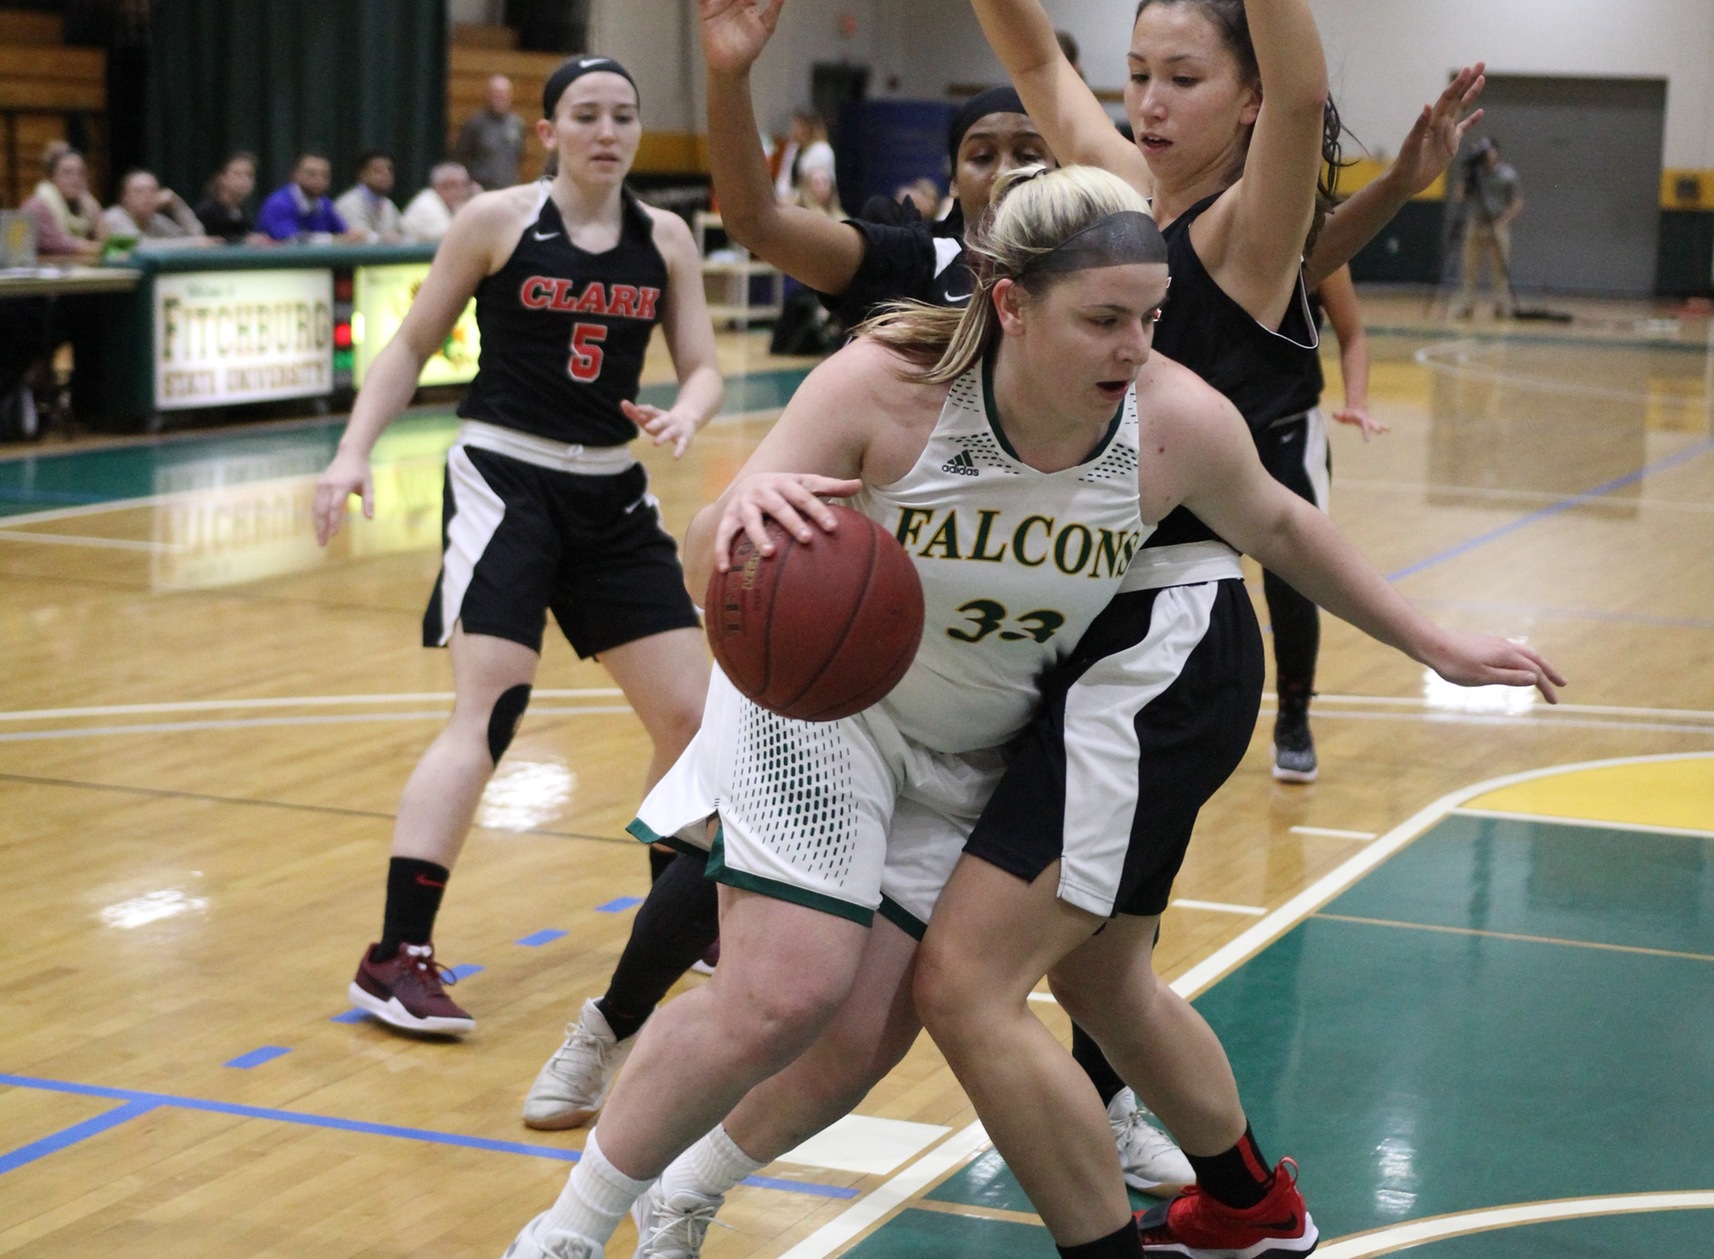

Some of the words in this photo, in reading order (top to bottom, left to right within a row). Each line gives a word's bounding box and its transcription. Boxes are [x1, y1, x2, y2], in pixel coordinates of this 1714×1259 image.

[520, 275, 660, 320] CLARK
[567, 322, 608, 383] 5
[941, 463, 980, 477] adidas
[896, 505, 1140, 579] FALCONS
[945, 597, 1066, 644] 33
